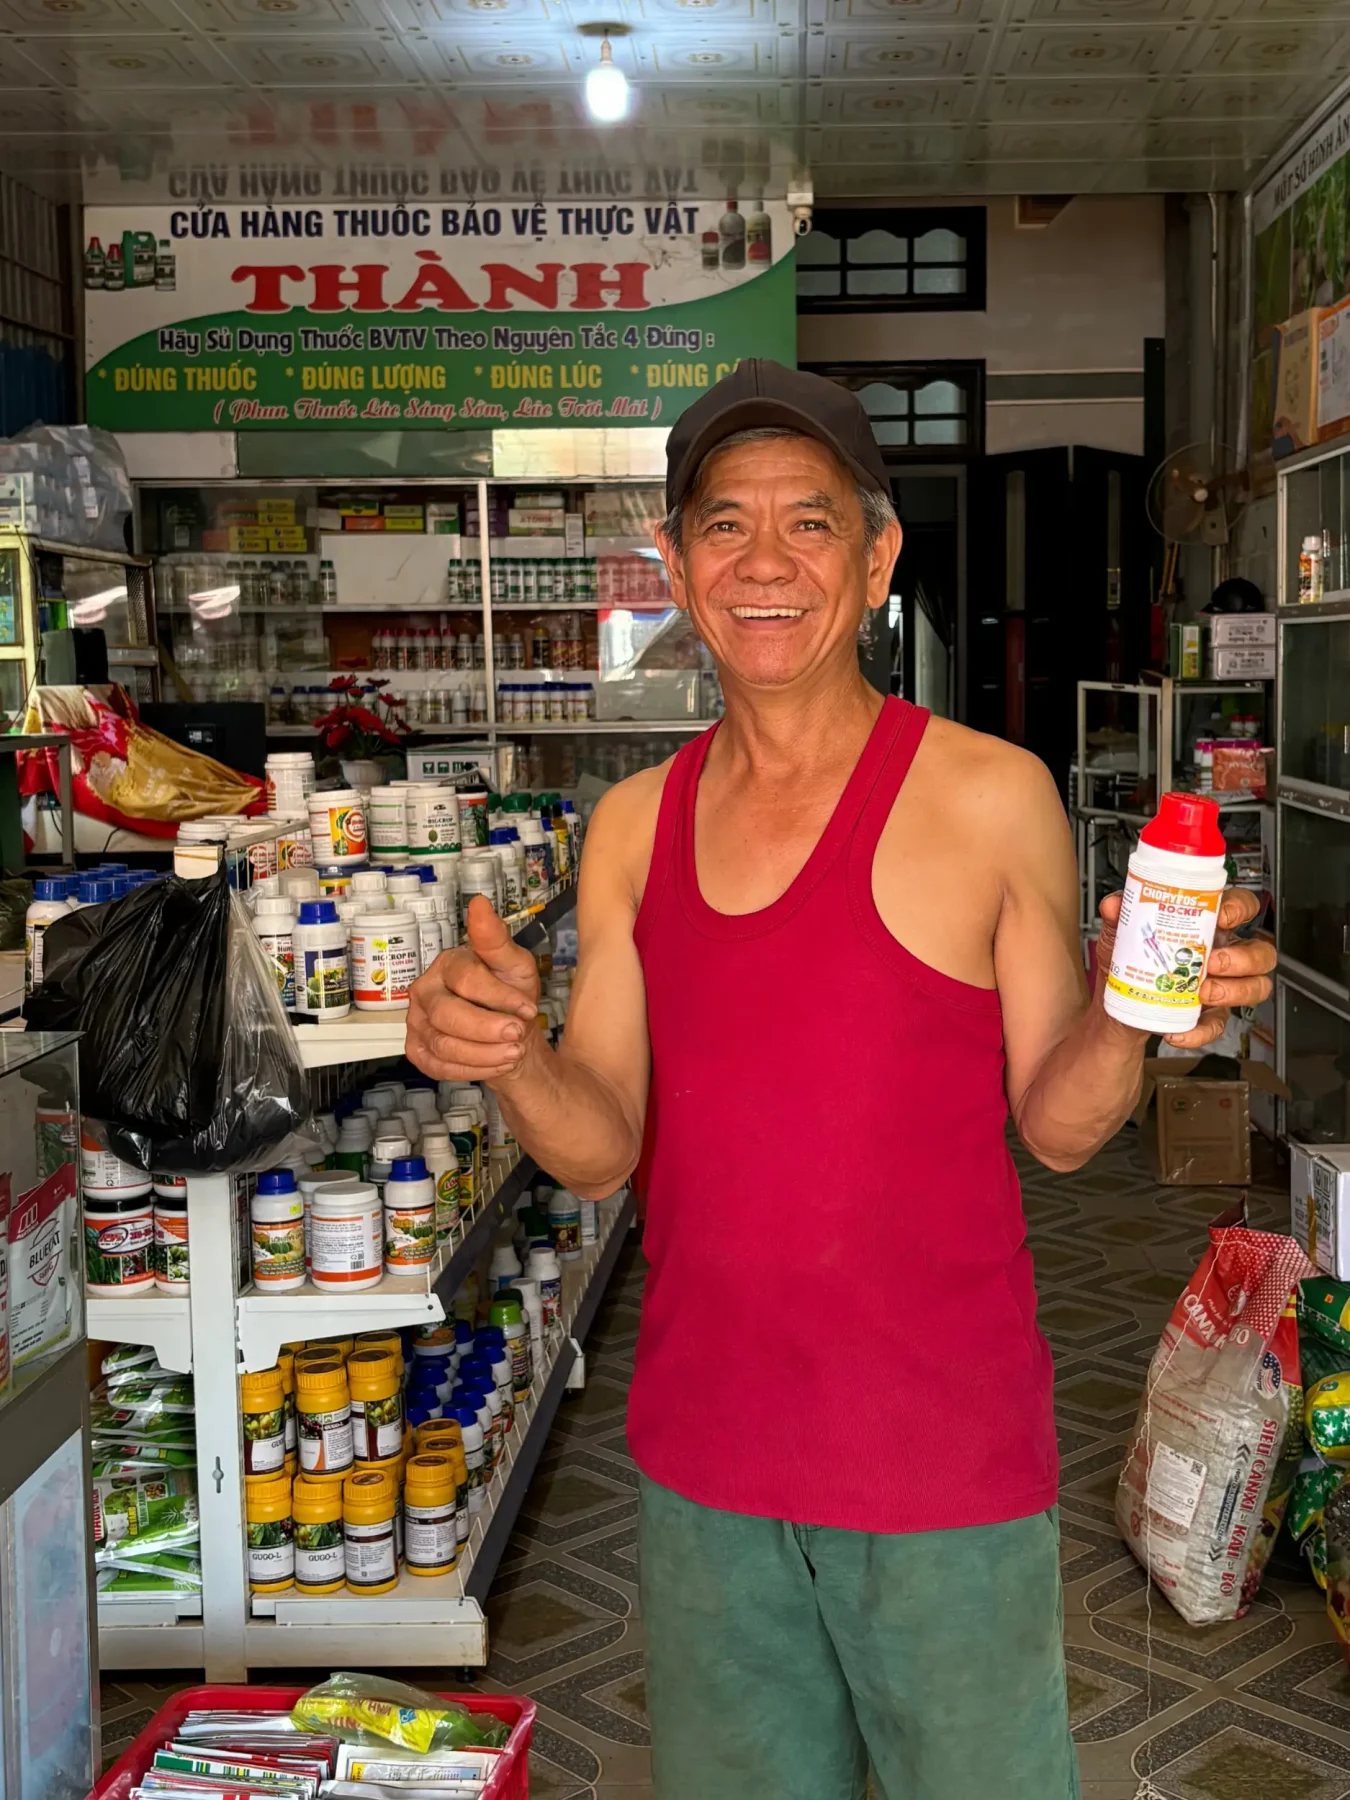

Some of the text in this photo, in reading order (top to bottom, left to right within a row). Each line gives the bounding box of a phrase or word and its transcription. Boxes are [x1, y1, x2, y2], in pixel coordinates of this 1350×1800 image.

[170, 202, 231, 238] CỬA
[240, 205, 323, 238] HÀNG
[442, 201, 500, 236] BẢO
[512, 203, 547, 241] VỆ
[558, 204, 633, 241] THỰC
[645, 202, 699, 240] VẬT
[231, 249, 651, 311] THÀNH
[159, 328, 200, 356] Hãy
[237, 328, 292, 356] Dụng
[299, 323, 363, 351] Thuốc
[369, 328, 426, 350] BVTV
[434, 327, 486, 349] Theo
[492, 327, 573, 354] Nguyên
[580, 323, 618, 349] Tắc
[623, 327, 638, 348] 4
[646, 325, 702, 353] Đúng
[114, 359, 257, 391] ĐÚNG THUỐC
[302, 362, 446, 395] ĐÚNG LƯỢNG
[491, 360, 602, 389] ĐÚNG LÚC
[647, 360, 708, 387] ĐÚNG
[229, 399, 289, 422] Phun
[294, 396, 357, 418] Thuốc
[361, 398, 401, 418] Lúc
[403, 397, 456, 421] Sáng
[513, 397, 552, 417] Lúc
[557, 396, 603, 417] Trời
[606, 397, 648, 417] Mát
[1158, 903, 1203, 917] ROCKET
[29, 1231, 60, 1269] BLUECAT
[1239, 1458, 1267, 1513] CANXI
[252, 1552, 282, 1562] GUGO-L
[308, 1551, 338, 1562] GUGO-L
